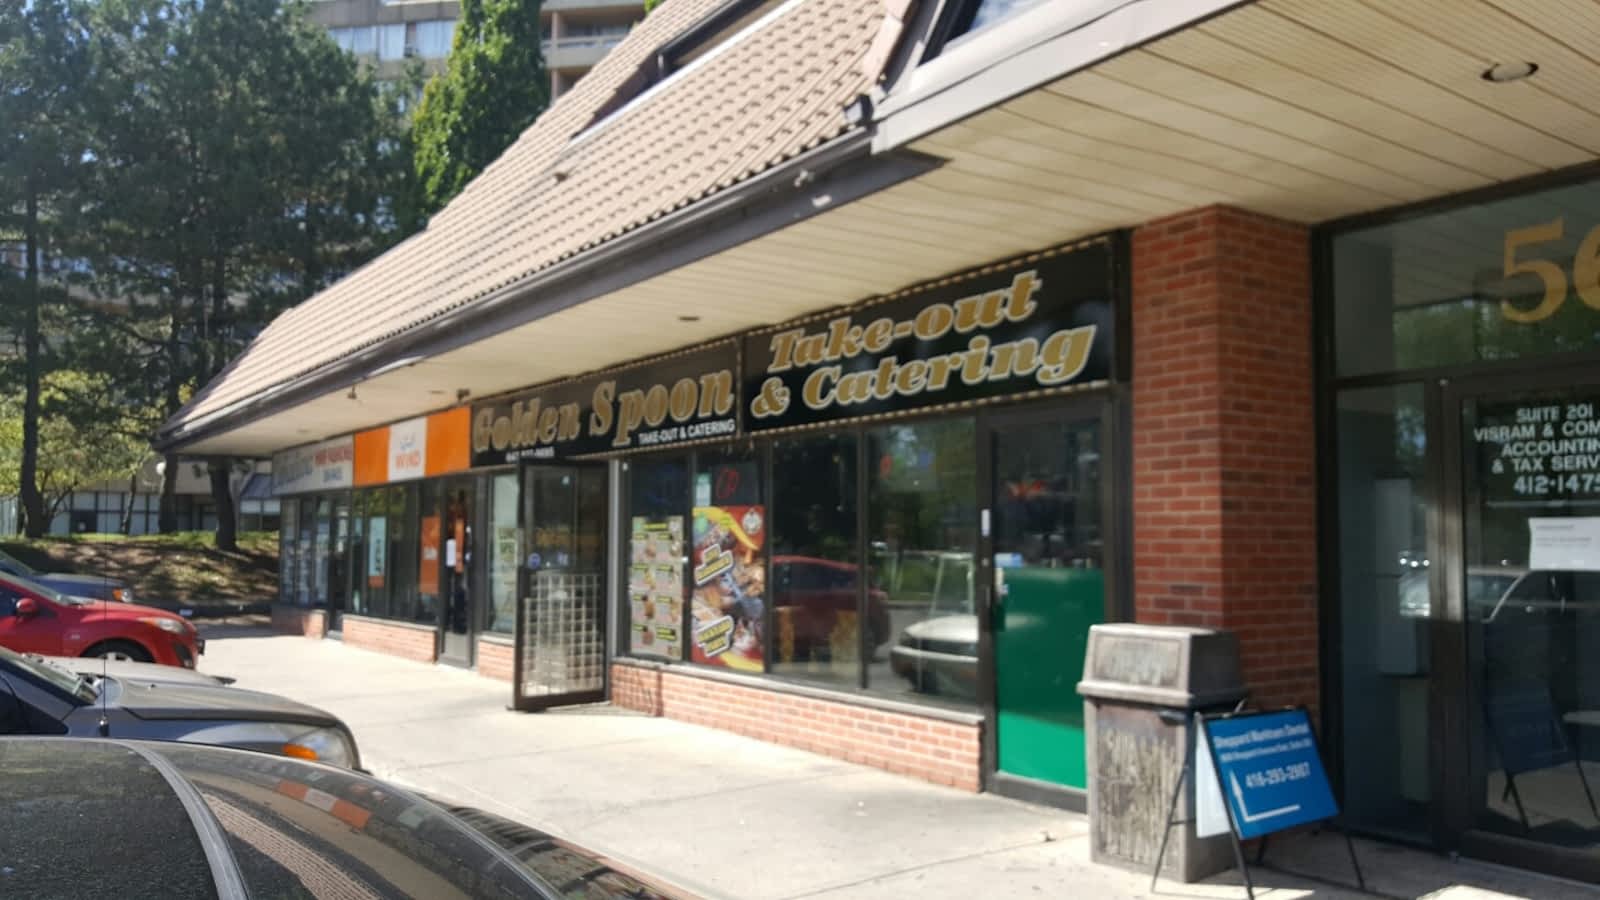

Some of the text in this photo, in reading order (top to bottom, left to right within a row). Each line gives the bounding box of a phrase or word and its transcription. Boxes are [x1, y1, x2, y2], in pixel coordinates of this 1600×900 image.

[767, 270, 1042, 373] Take-out
[751, 325, 1097, 417] & Catering
[473, 369, 735, 453] Golden Spoon
[1516, 403, 1593, 423] SUITE 201
[638, 431, 679, 445] TAKE-OUT
[687, 419, 735, 438] CATERING
[1473, 424, 1536, 442] VISRAM
[1542, 422, 1554, 438] &
[1491, 454, 1600, 474] & TAX SERV
